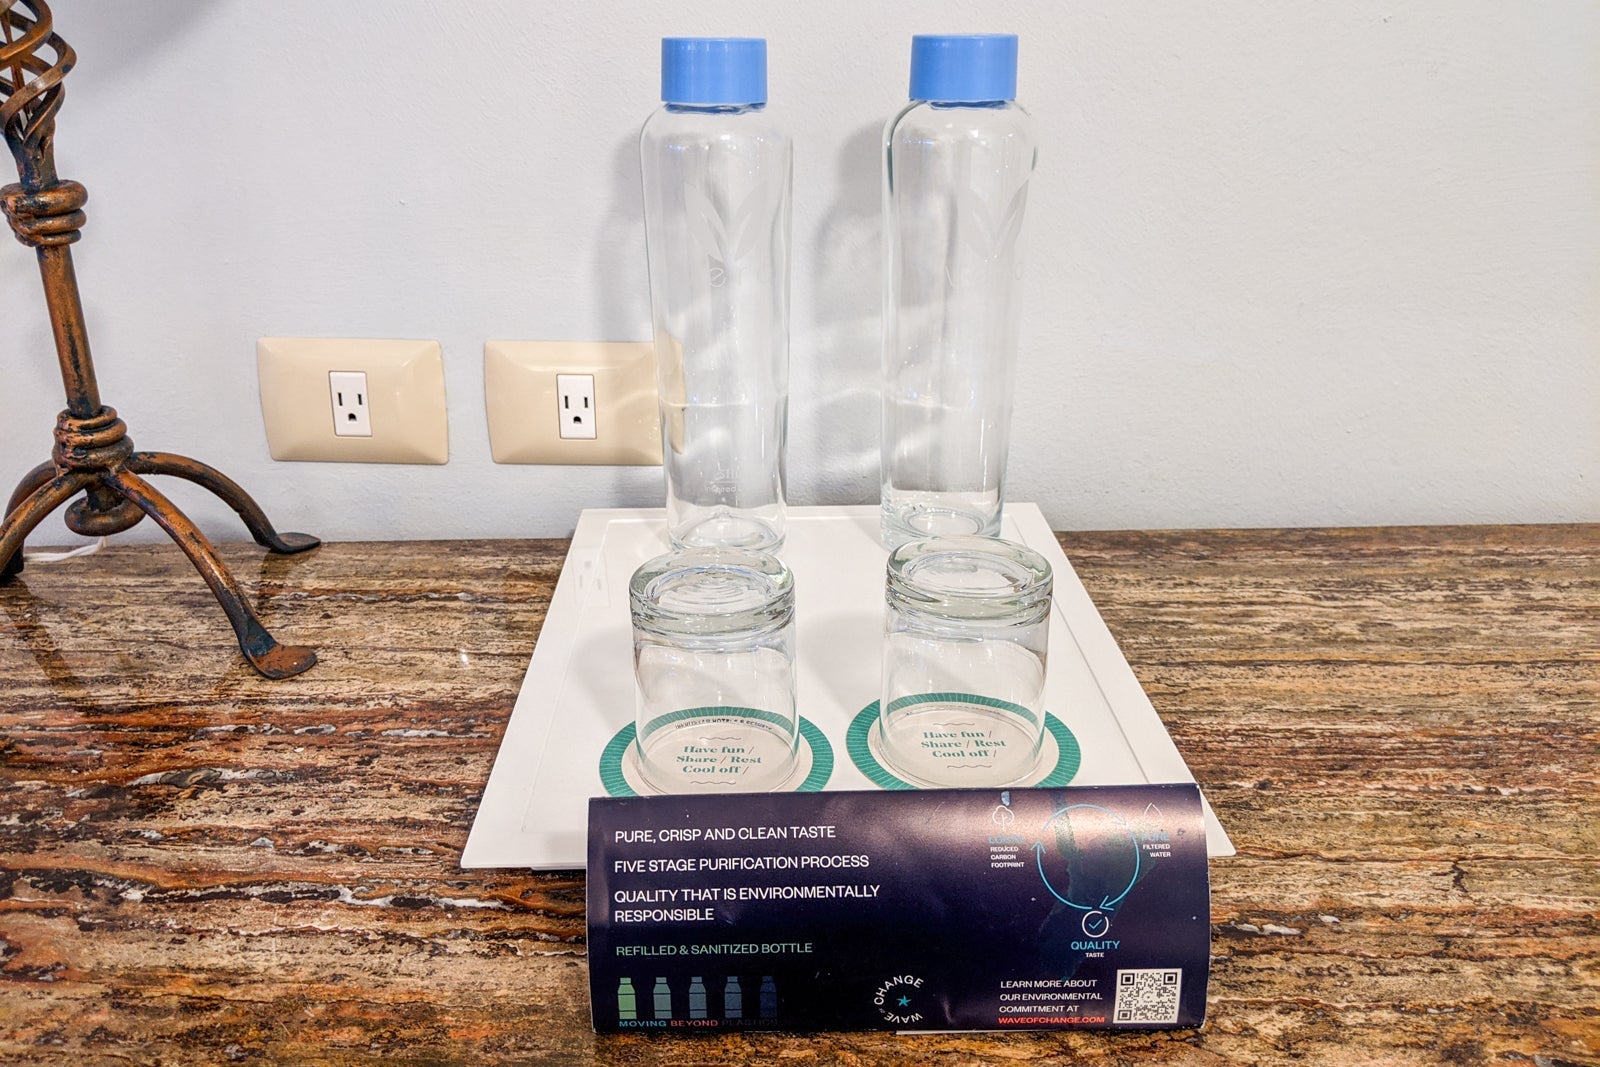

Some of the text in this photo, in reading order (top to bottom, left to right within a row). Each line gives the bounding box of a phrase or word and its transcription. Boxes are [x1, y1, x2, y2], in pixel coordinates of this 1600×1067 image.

[923, 731, 957, 739] Have
[961, 730, 985, 738] fun
[921, 740, 962, 748] Share
[974, 739, 1007, 747] Rest
[684, 746, 718, 754] Have
[721, 746, 745, 754] fun
[932, 749, 965, 758] Cool
[969, 749, 990, 757] off
[676, 755, 718, 763] Share
[731, 756, 762, 764] Rest
[682, 765, 715, 774] Cool
[719, 765, 742, 774] off
[615, 826, 836, 844] PURE, CRISP AND CLEAN TASTE
[614, 855, 870, 873] FIVE STAGE PURIFICATION PROCESS
[991, 861, 1025, 869] FOOTPRINT
[614, 884, 880, 904] QUALITY THAT IS ENVIRONMENTALLY
[614, 908, 715, 923] RESPONSIBLE
[616, 942, 813, 956] REFILLED & SANITIZED BOTTLE
[1070, 940, 1121, 950] QUALITY
[1000, 979, 1098, 989] LEARN MORE ABOUT
[873, 975, 924, 1024] WAVE CHANGE
[1000, 992, 1103, 1001] OUR ENVIRONMENTAL
[999, 1005, 1080, 1013] COMMITMENT AT
[618, 1020, 667, 1028] MOVING
[670, 1019, 719, 1027] BEYOND
[998, 1016, 1105, 1024] WAVEOFCHANGE.COM
